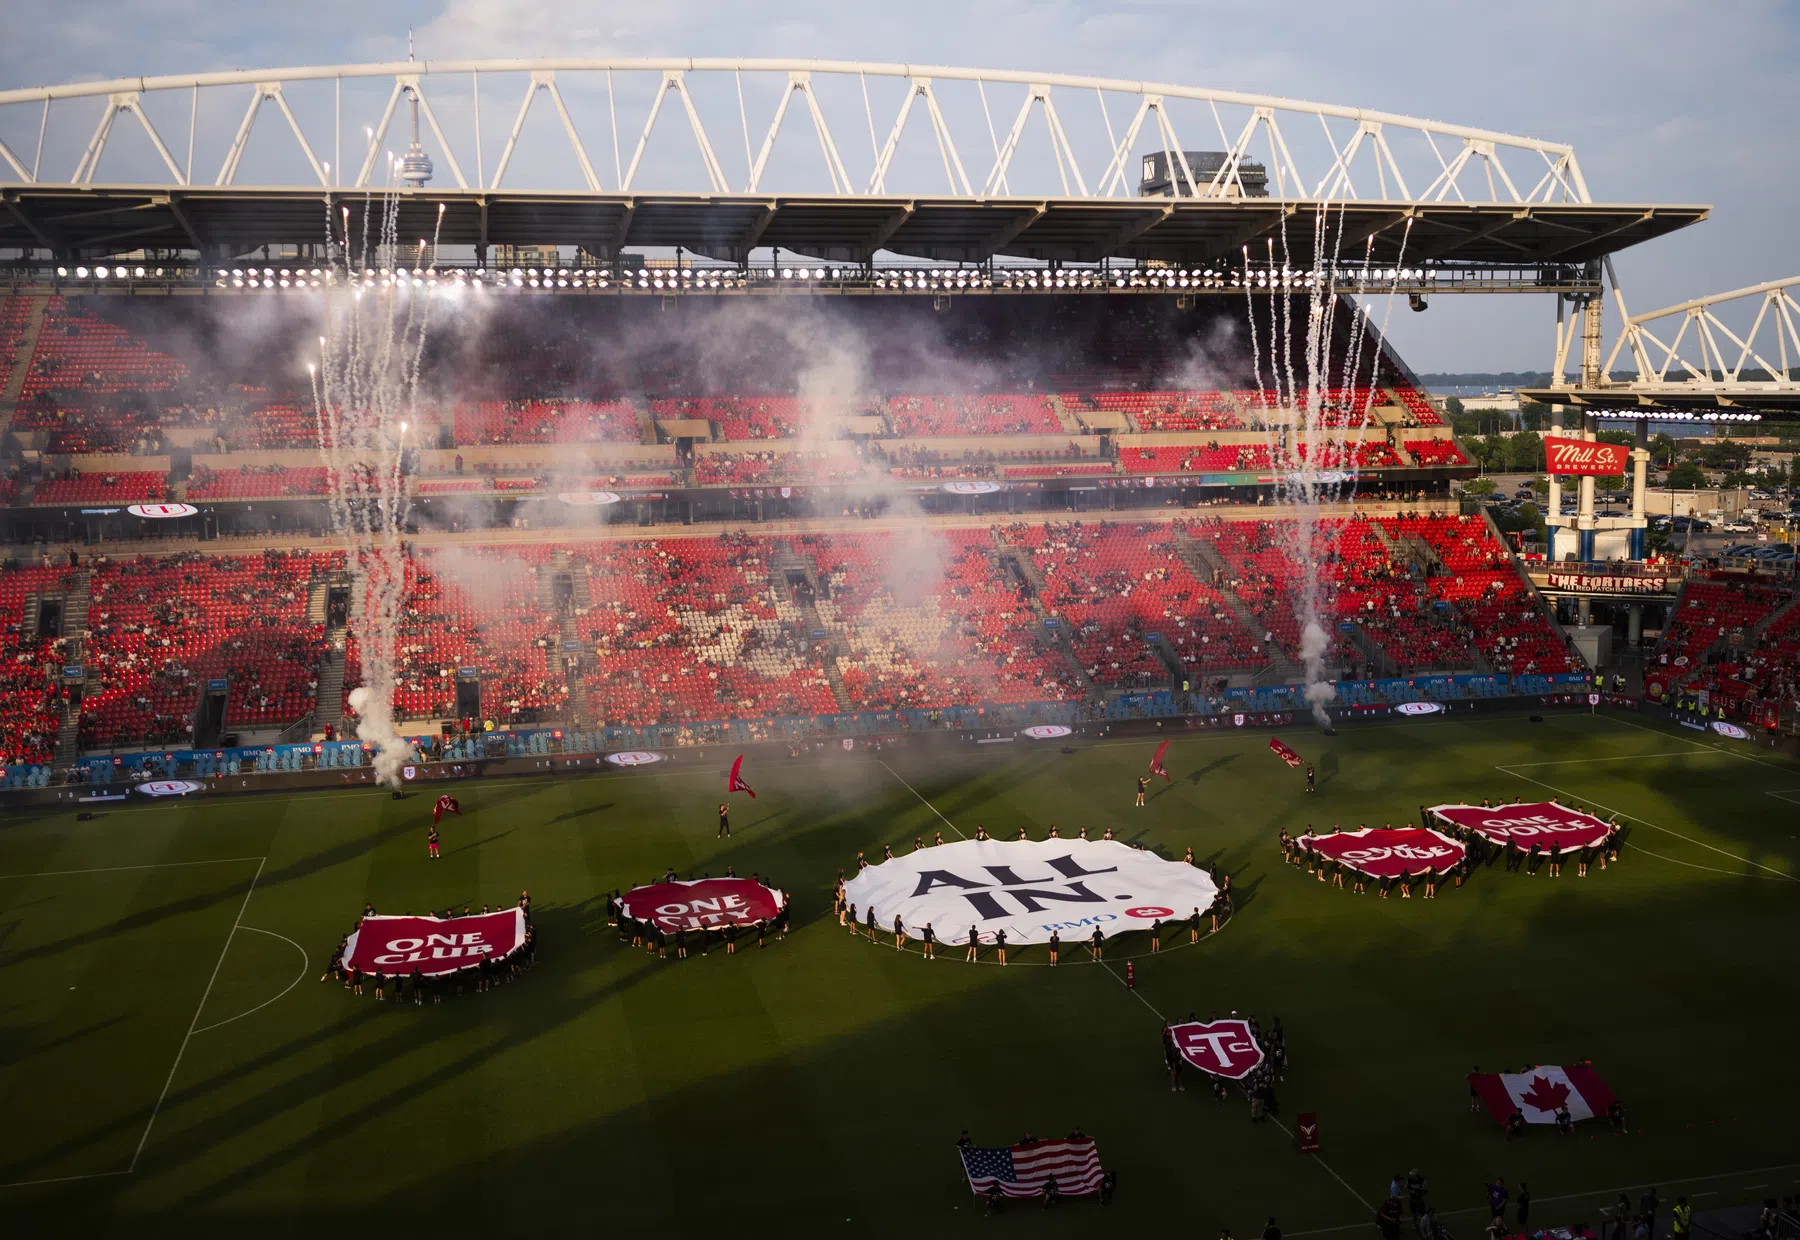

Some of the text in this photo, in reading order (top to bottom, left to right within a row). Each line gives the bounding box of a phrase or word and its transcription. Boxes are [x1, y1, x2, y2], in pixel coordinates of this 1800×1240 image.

[1551, 444, 1618, 464] Mill St.
[1550, 573, 1664, 592] THE FORTRESS
[1482, 815, 1559, 827] ONE
[1484, 819, 1595, 837] VOICE
[909, 853, 1118, 898] ALL
[655, 894, 746, 915] ONE
[962, 880, 1133, 920] IN.
[657, 906, 751, 928] CITY
[1042, 913, 1118, 932] BMO
[386, 932, 485, 952] ONE
[373, 944, 493, 964] CLUB
